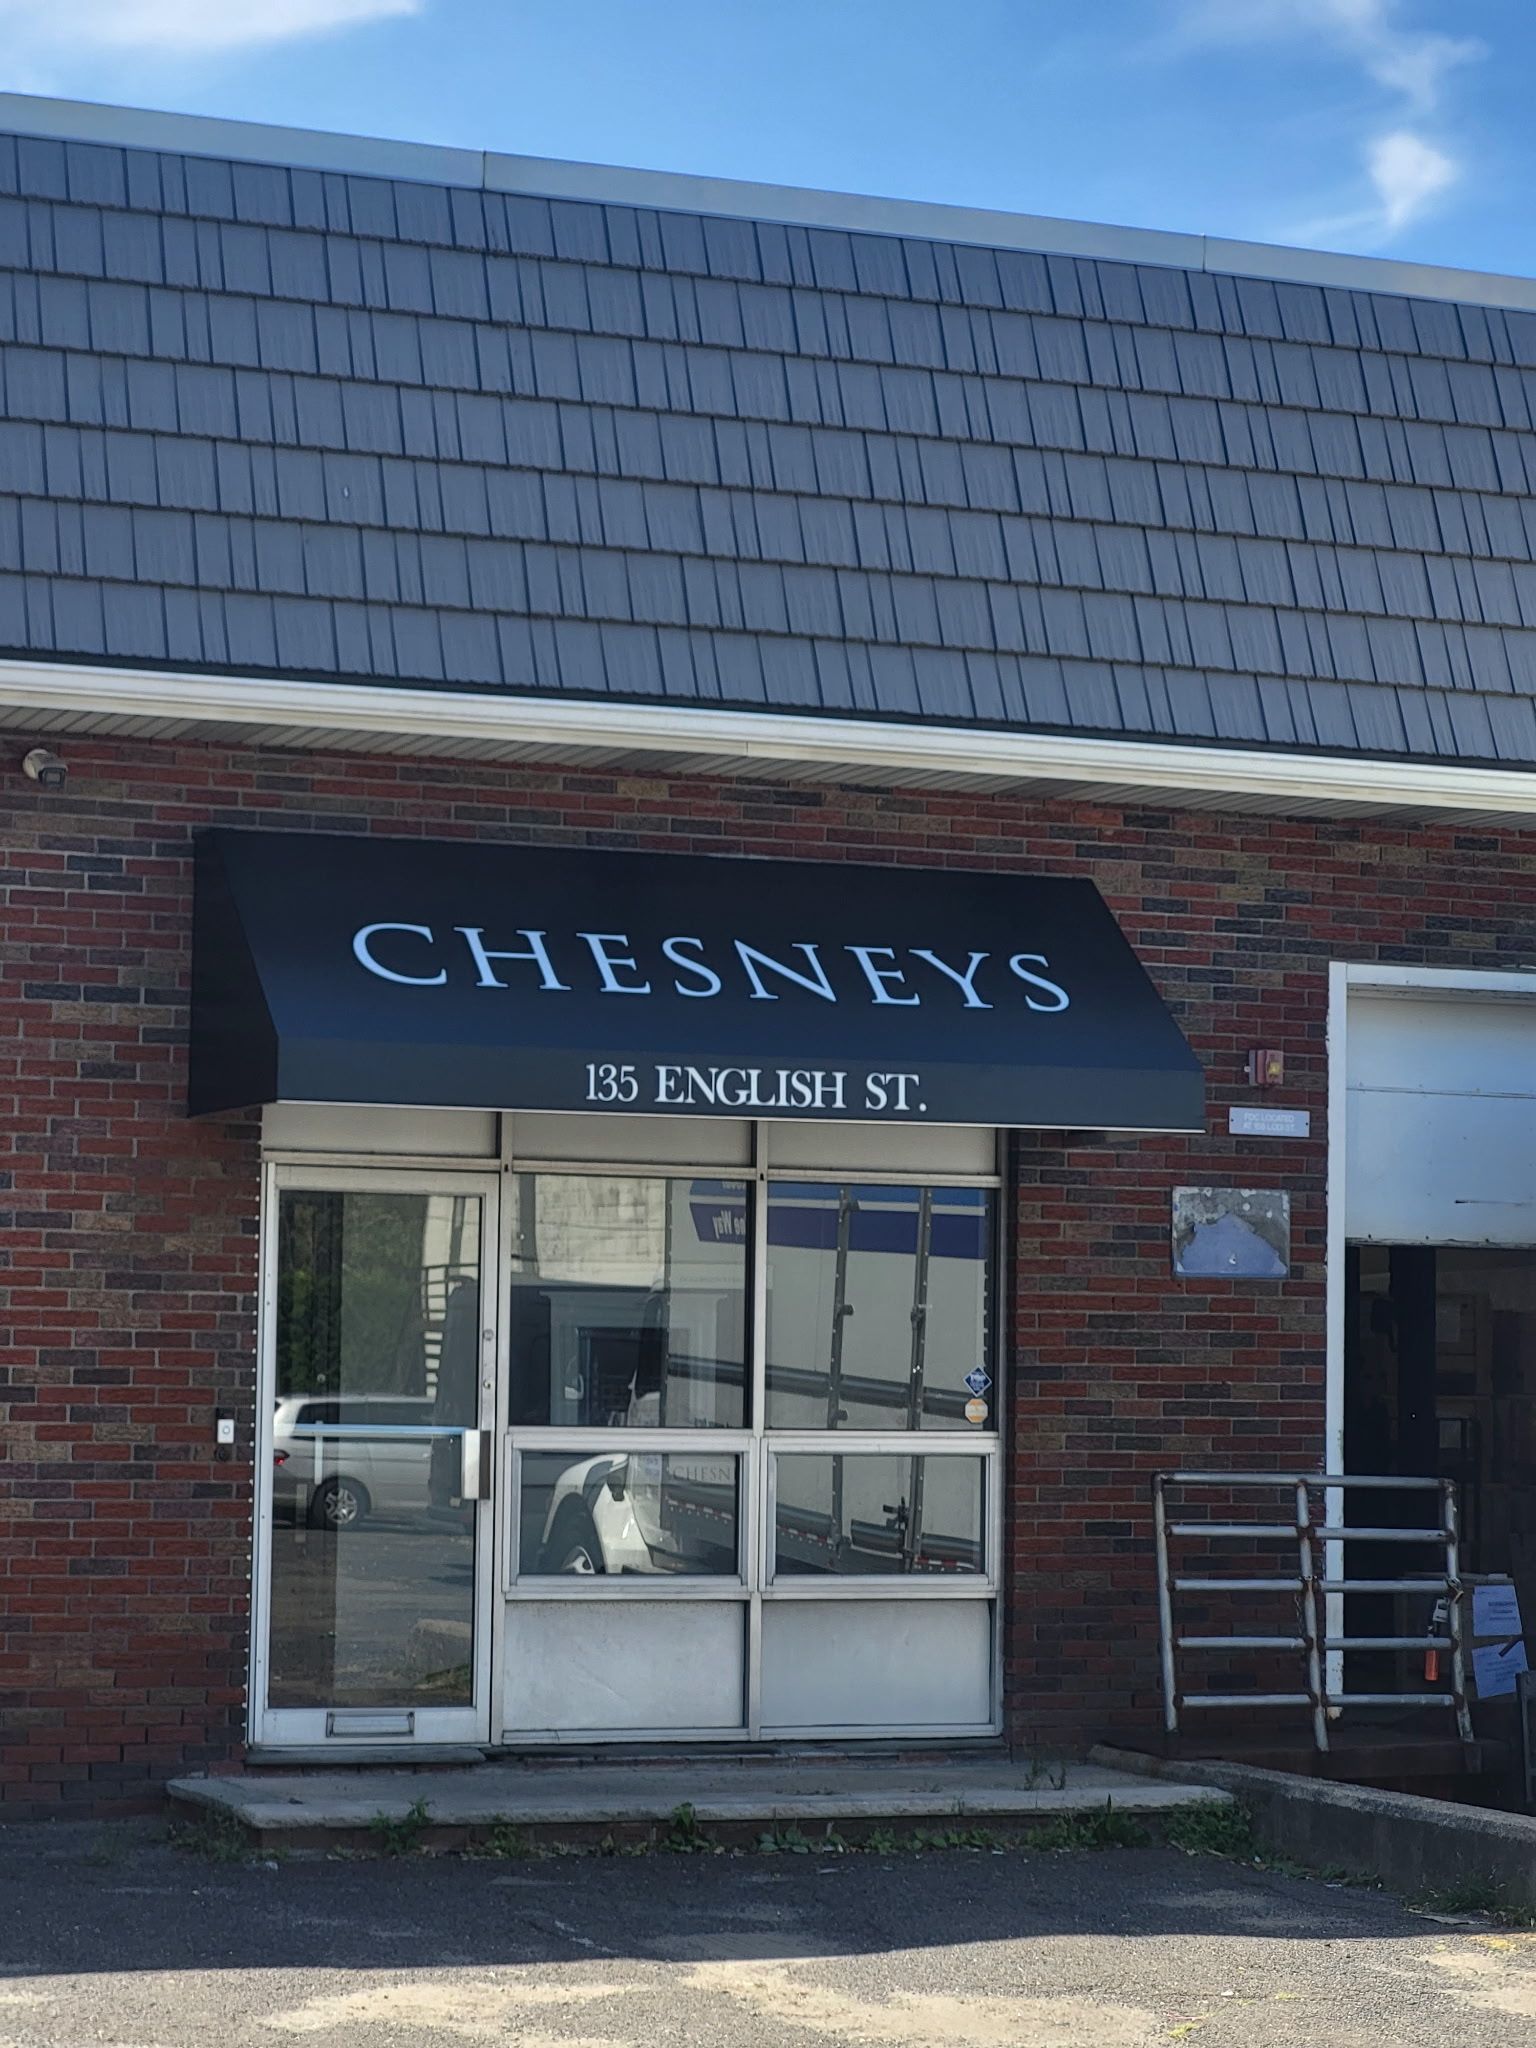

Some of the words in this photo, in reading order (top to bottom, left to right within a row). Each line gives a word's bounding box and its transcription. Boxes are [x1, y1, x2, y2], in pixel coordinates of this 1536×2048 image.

[353, 923, 1069, 1012] CHESNEYS
[586, 1063, 639, 1102] 135
[655, 1066, 847, 1109] ENGLISH
[865, 1072, 927, 1112] ST.
